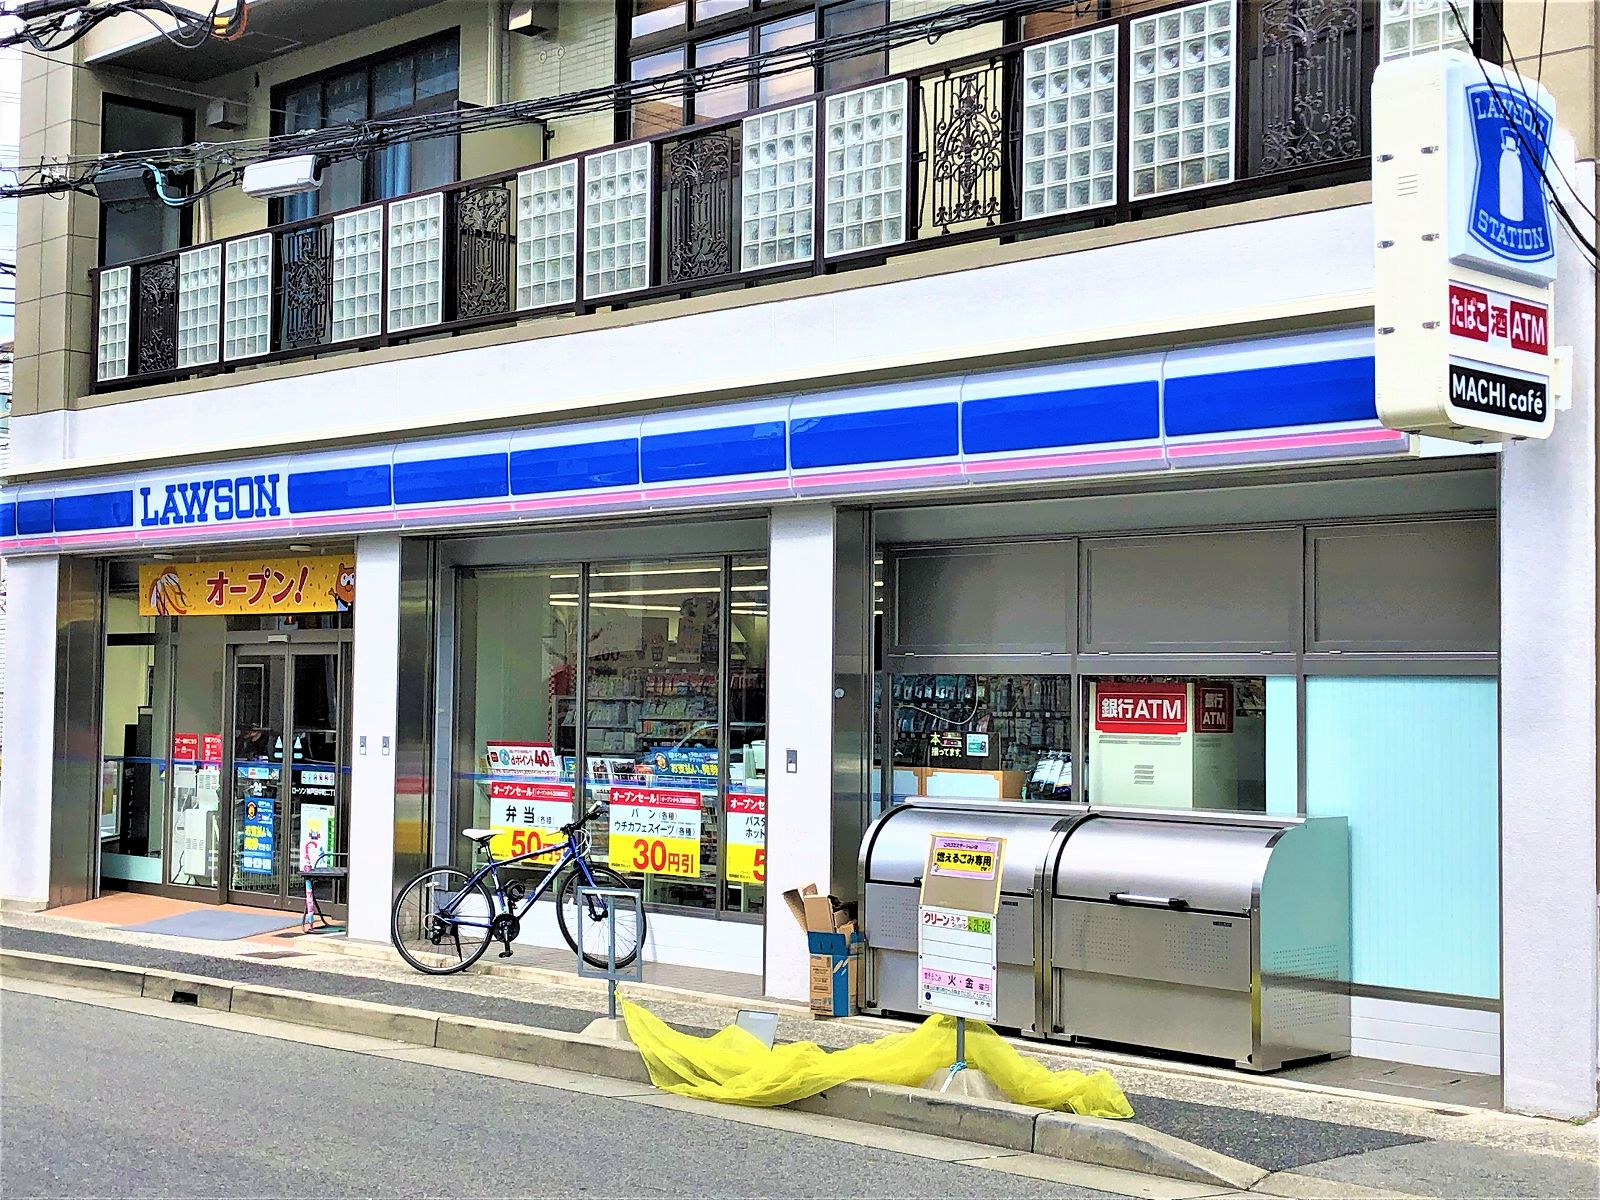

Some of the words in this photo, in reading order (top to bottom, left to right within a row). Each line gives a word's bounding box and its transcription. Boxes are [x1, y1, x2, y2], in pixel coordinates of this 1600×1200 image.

[1475, 97, 1546, 141] LAWSON
[1478, 209, 1545, 251] STATION
[1450, 296, 1488, 333] たばこ
[1491, 304, 1508, 339] 酒
[1511, 311, 1546, 346] ATM
[1452, 374, 1506, 408] MACHI
[1508, 389, 1543, 416] café
[139, 473, 281, 527] LAWSON
[206, 565, 310, 607] オープン!
[1100, 696, 1182, 721] 銀行ATM
[1203, 711, 1226, 725] ATM
[1204, 693, 1224, 709] 銀行
[613, 820, 675, 836] ウチカフェスイーツ
[632, 838, 695, 874] 30円引
[936, 851, 992, 868] 燃えるごみ専用
[923, 911, 950, 927] クリーン
